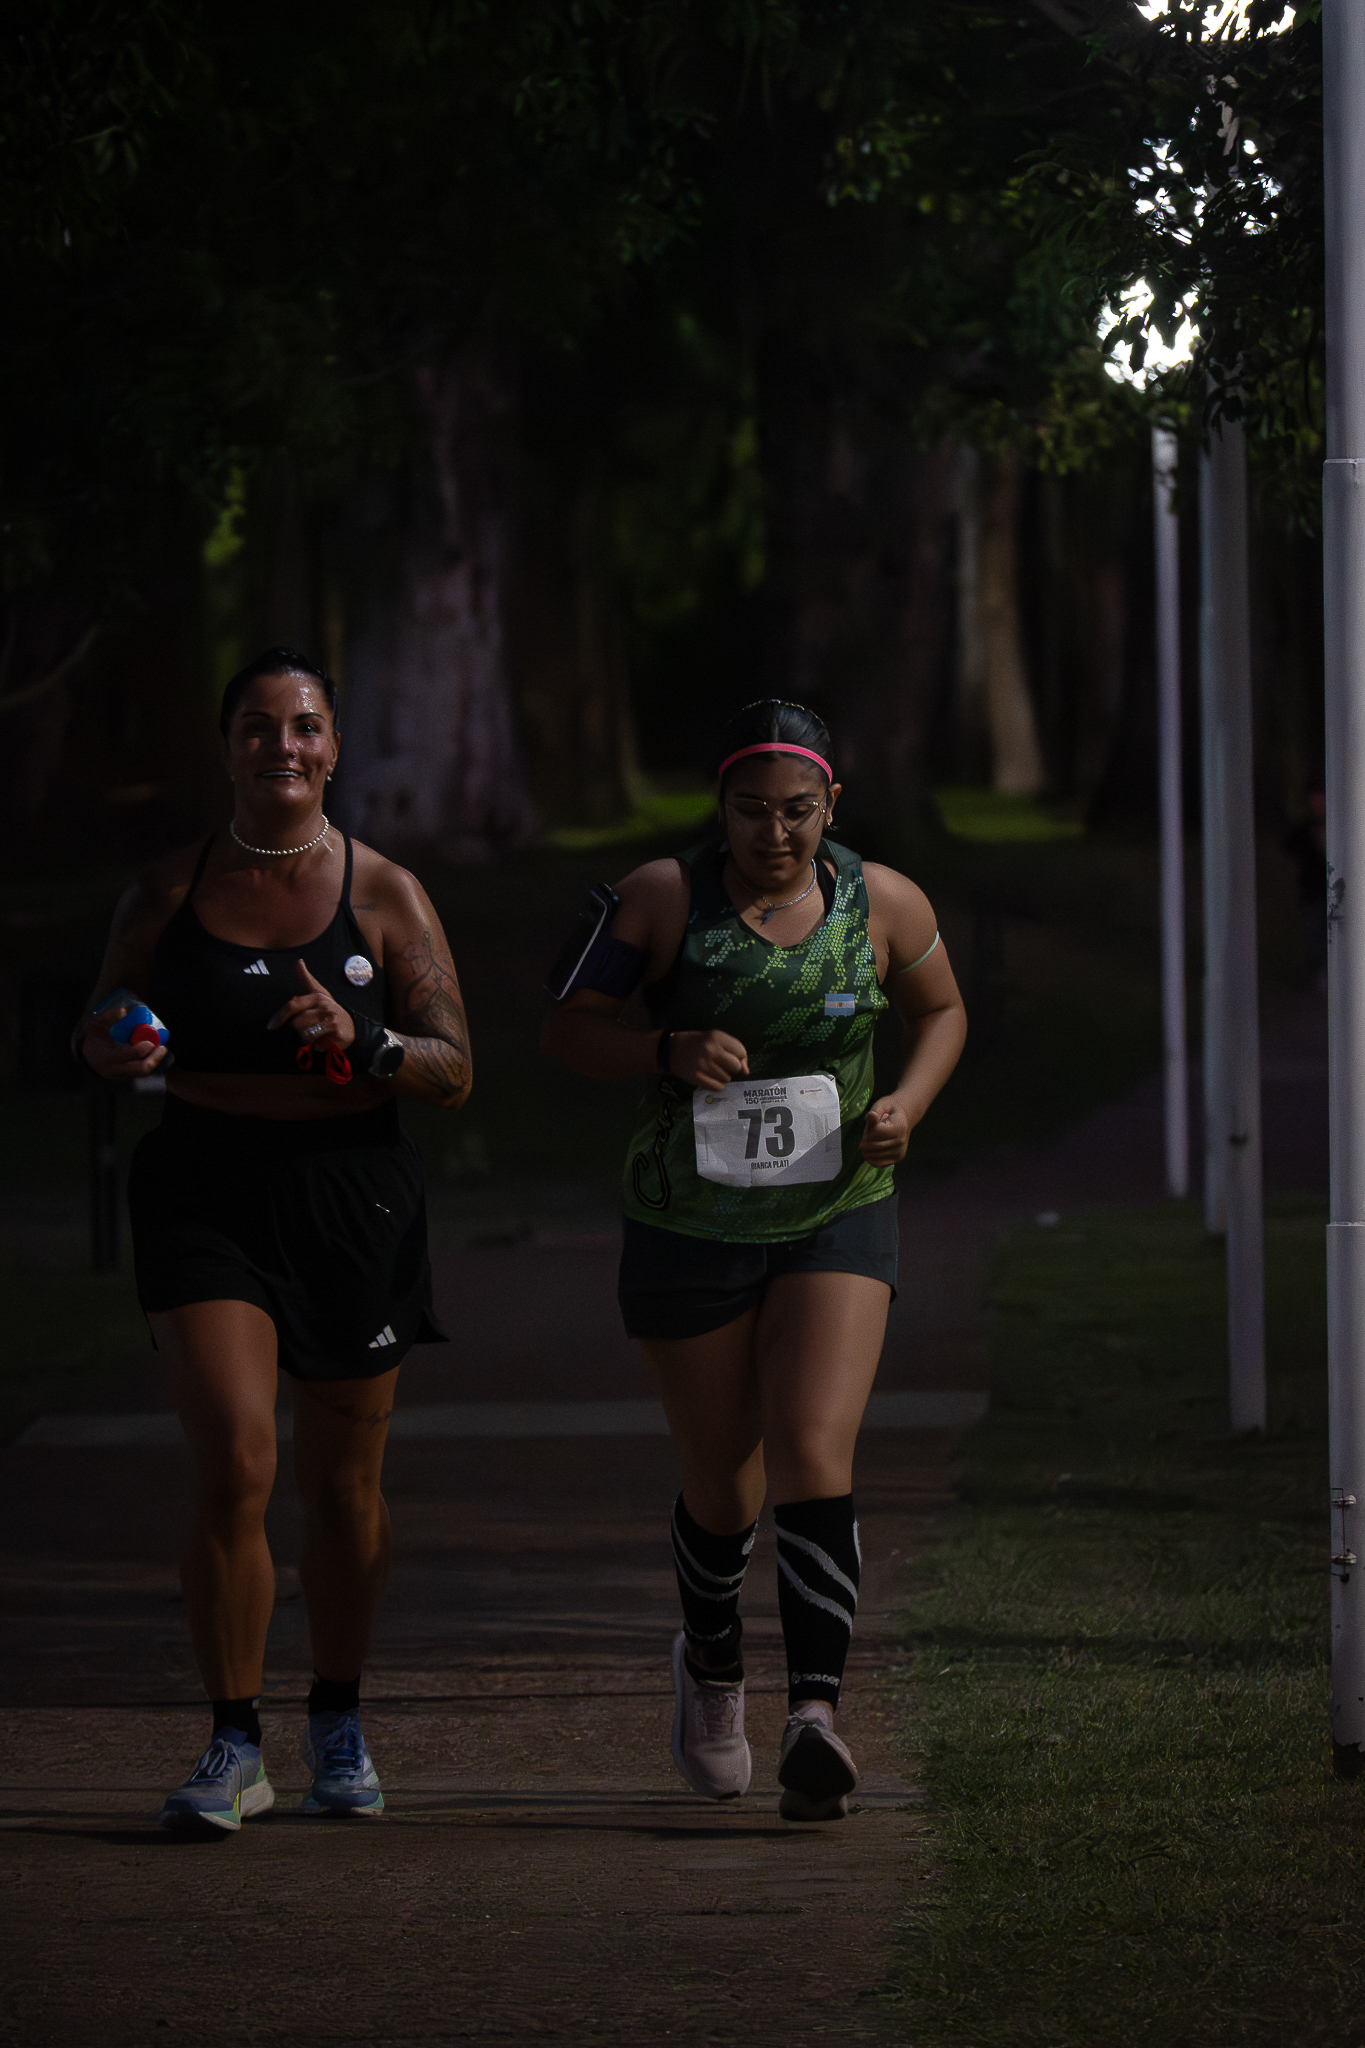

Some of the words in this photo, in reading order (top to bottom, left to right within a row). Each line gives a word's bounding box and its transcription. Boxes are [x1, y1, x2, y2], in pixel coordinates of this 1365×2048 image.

[743, 1086, 787, 1098] MARATÓN
[745, 1097, 759, 1105] 150
[738, 1106, 795, 1159] 73
[751, 1161, 772, 1170] BIANCA
